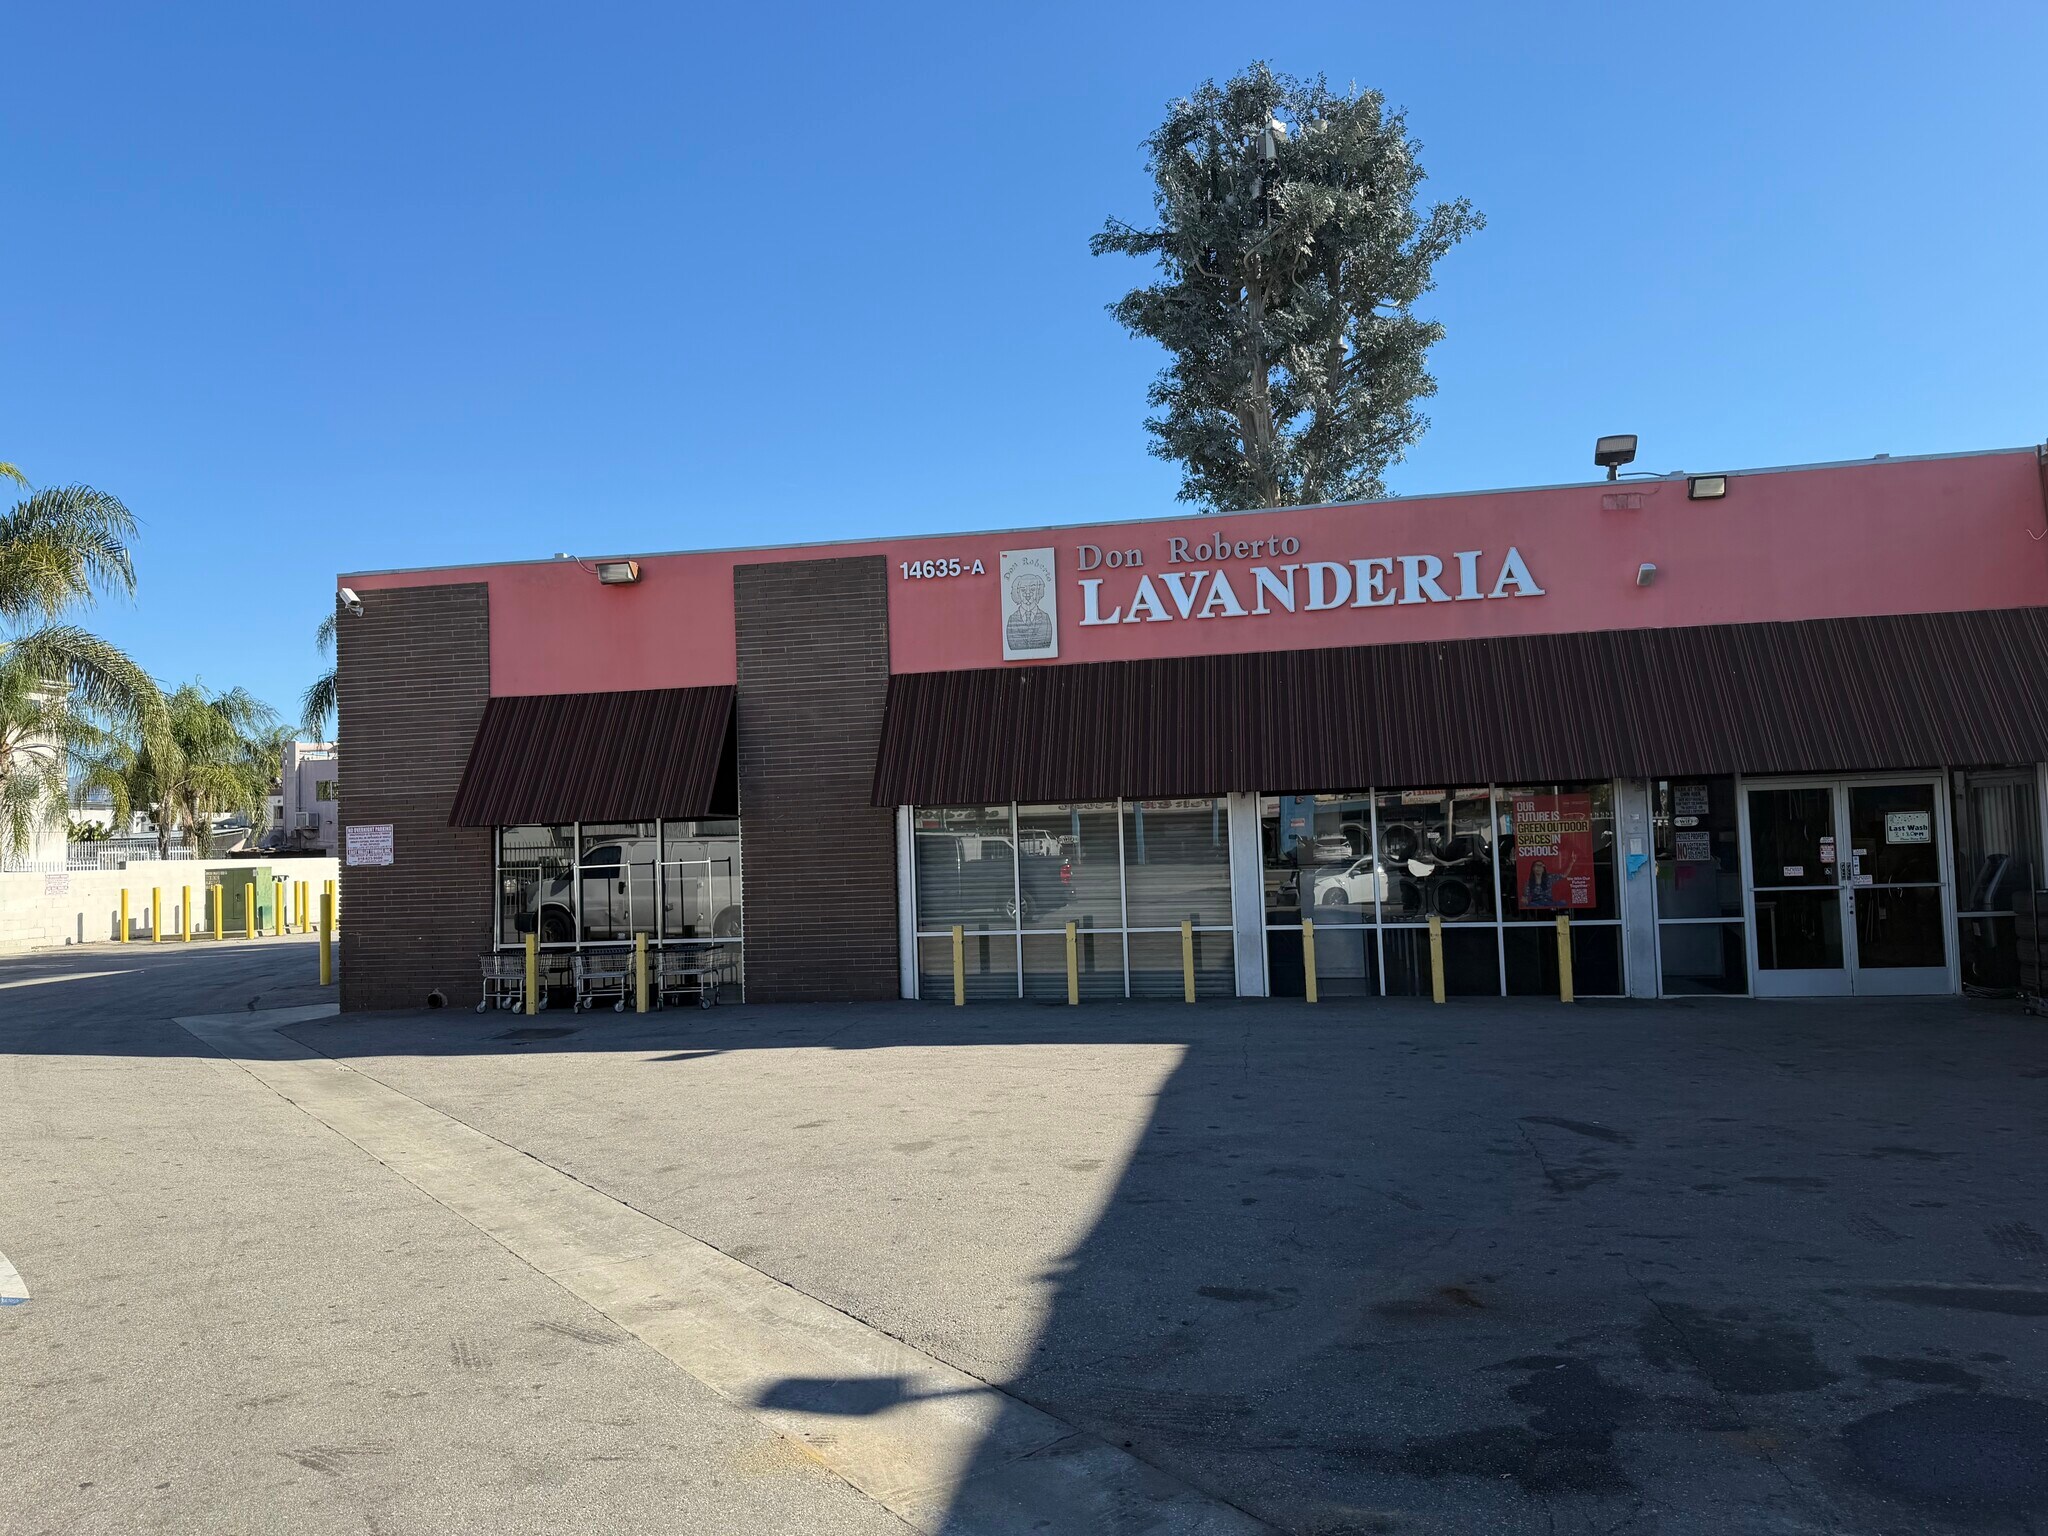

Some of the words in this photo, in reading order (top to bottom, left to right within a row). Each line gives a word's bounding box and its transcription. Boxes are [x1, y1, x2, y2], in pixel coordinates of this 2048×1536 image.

[1077, 545, 1143, 571] Don
[1168, 532, 1300, 563] Roberto
[900, 558, 985, 579] 14635-A
[1078, 547, 1546, 627] LAVANDERIA
[1517, 801, 1535, 812] OUR
[1517, 811, 1550, 822] FUTURE
[1551, 810, 1560, 821] IS
[1517, 823, 1546, 833] GREEN
[1547, 821, 1588, 832] OUTDOOR
[1518, 834, 1550, 845] SPACES
[1551, 834, 1561, 844] IN
[1519, 845, 1559, 857] SCHOOLS
